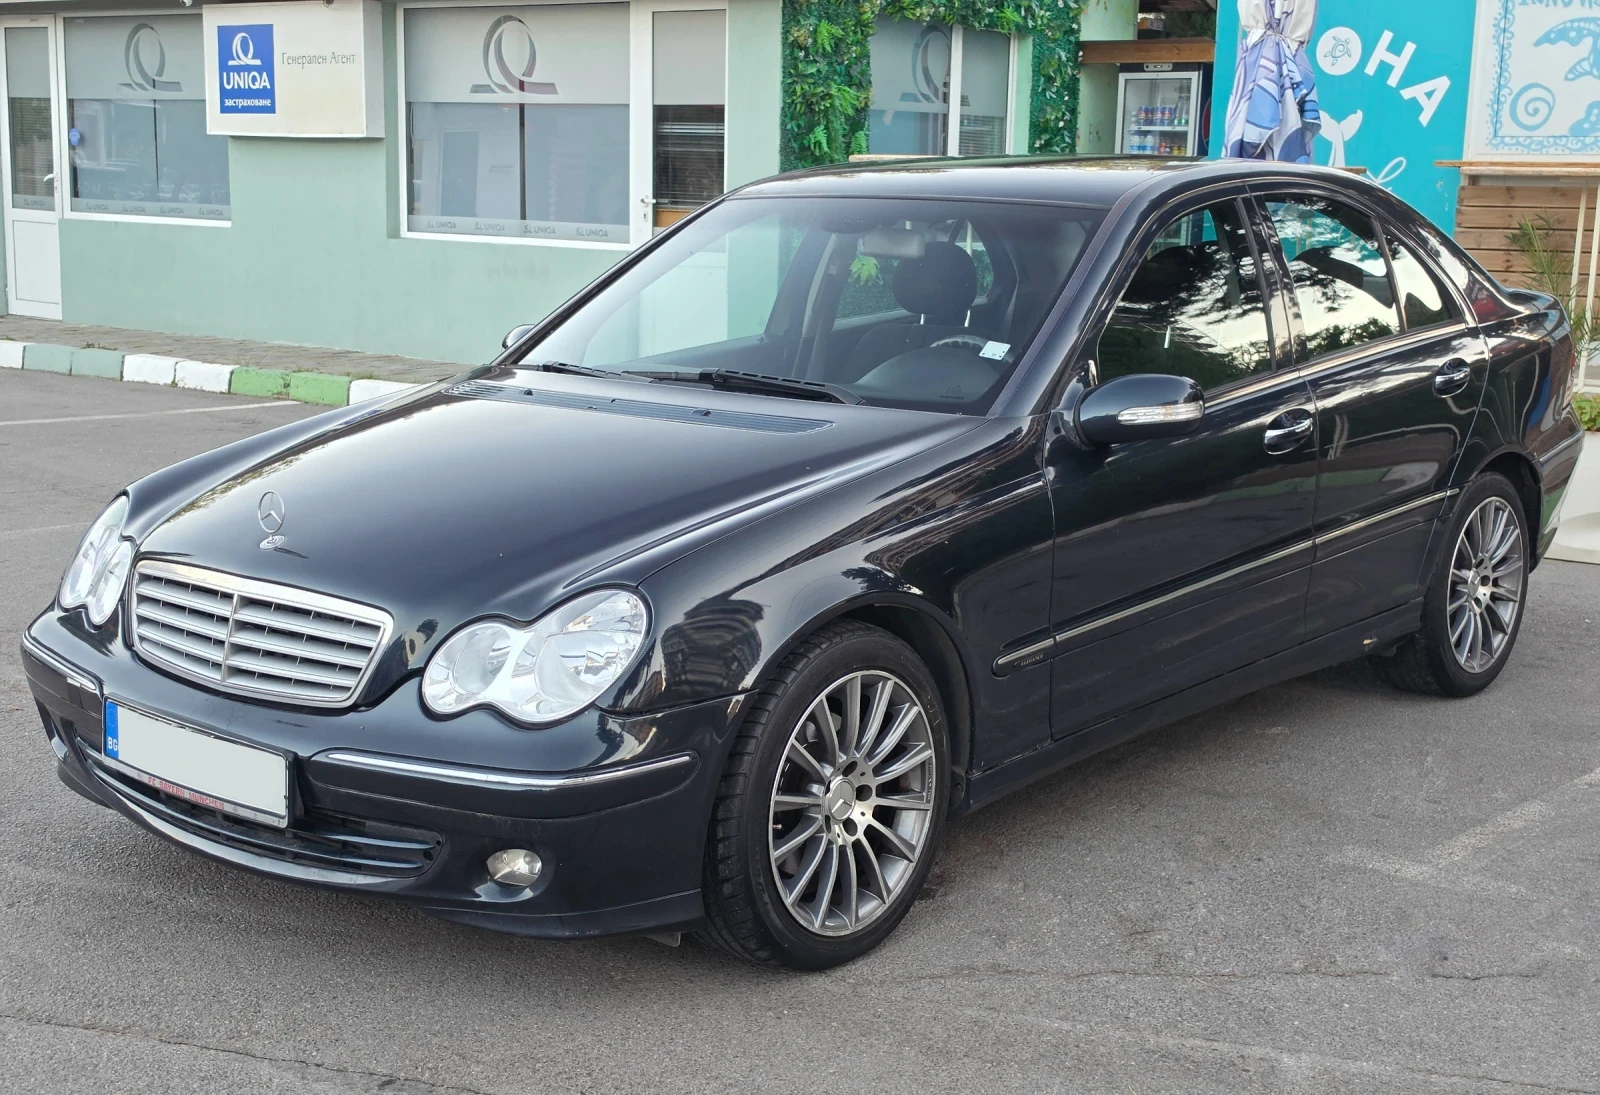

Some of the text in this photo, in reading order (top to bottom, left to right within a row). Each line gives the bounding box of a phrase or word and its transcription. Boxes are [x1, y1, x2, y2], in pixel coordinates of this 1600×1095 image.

[282, 51, 356, 69] Генерален Агент
[223, 71, 271, 89] UNIQA
[1316, 27, 1450, 127] OHA
[224, 98, 272, 108] застраховане
[436, 221, 457, 229] UNIQA
[586, 228, 609, 238] UNIQA
[108, 736, 118, 751] BG
[148, 776, 156, 786] FC
[160, 780, 185, 797] BAYERN
